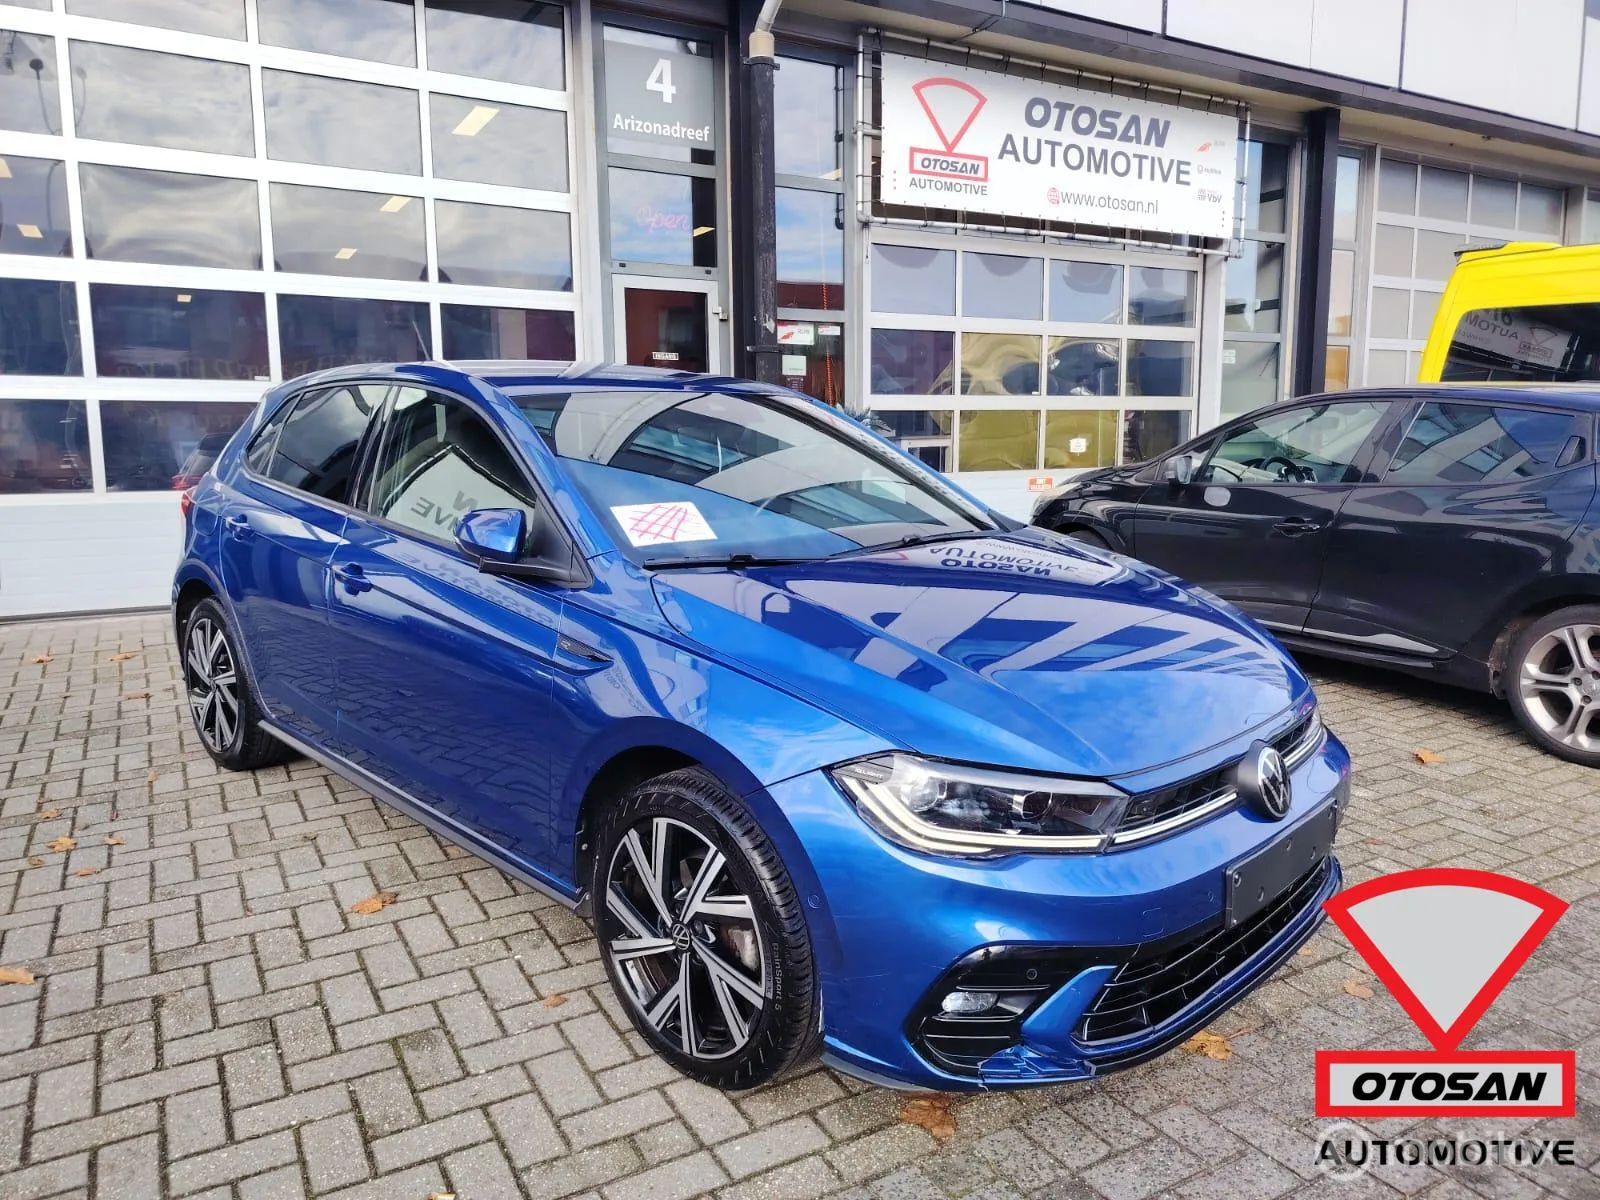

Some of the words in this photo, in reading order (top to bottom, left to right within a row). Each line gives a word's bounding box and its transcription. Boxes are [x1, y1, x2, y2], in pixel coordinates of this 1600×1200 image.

[646, 58, 676, 104] 4
[613, 113, 710, 142] Arizonadreef
[1024, 97, 1171, 148] OTOSAN
[921, 157, 980, 175] OTOSAN
[997, 133, 1192, 186] AUTOMOTIVE
[909, 177, 988, 196] AUTOMOTIVE
[1060, 191, 1158, 214] www.otosan.nl
